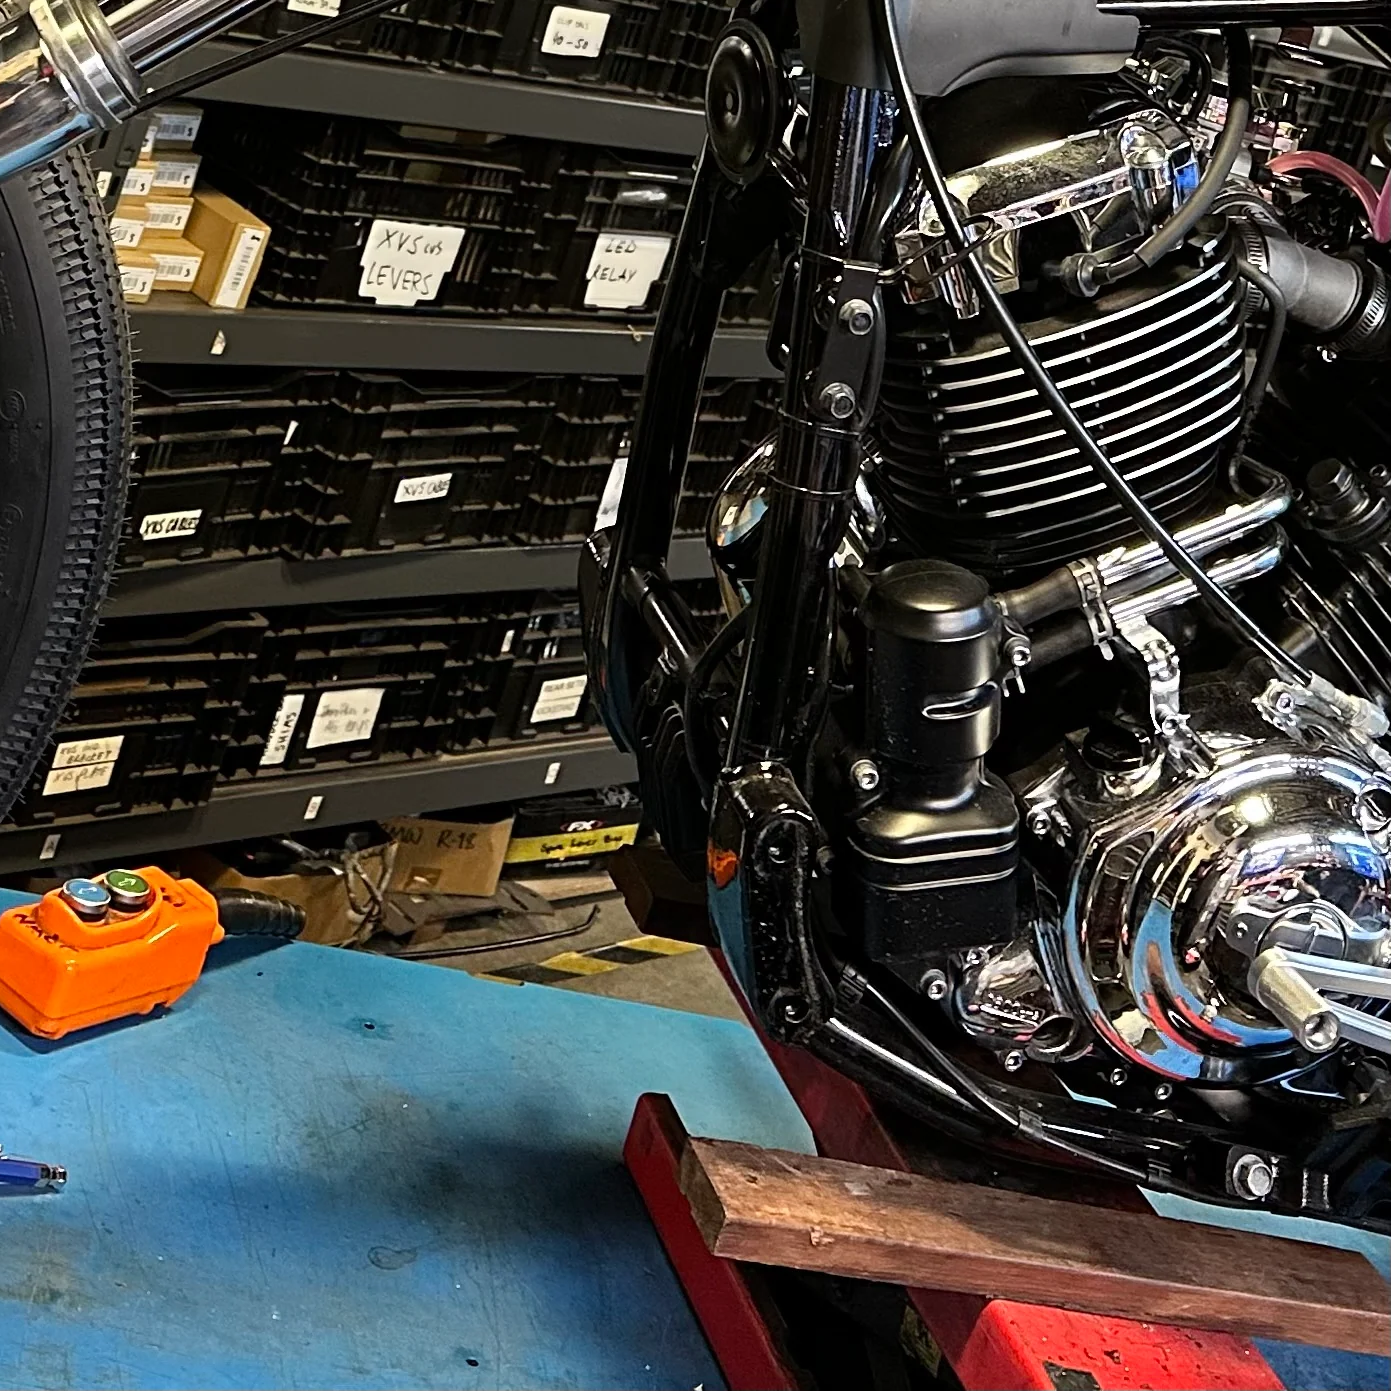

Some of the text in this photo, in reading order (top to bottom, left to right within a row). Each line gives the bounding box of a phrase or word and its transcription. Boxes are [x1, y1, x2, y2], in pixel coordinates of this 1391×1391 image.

[377, 228, 417, 255] XVS
[605, 239, 638, 253] LED
[366, 261, 433, 296] LEVERS
[590, 267, 638, 283] RELAY
